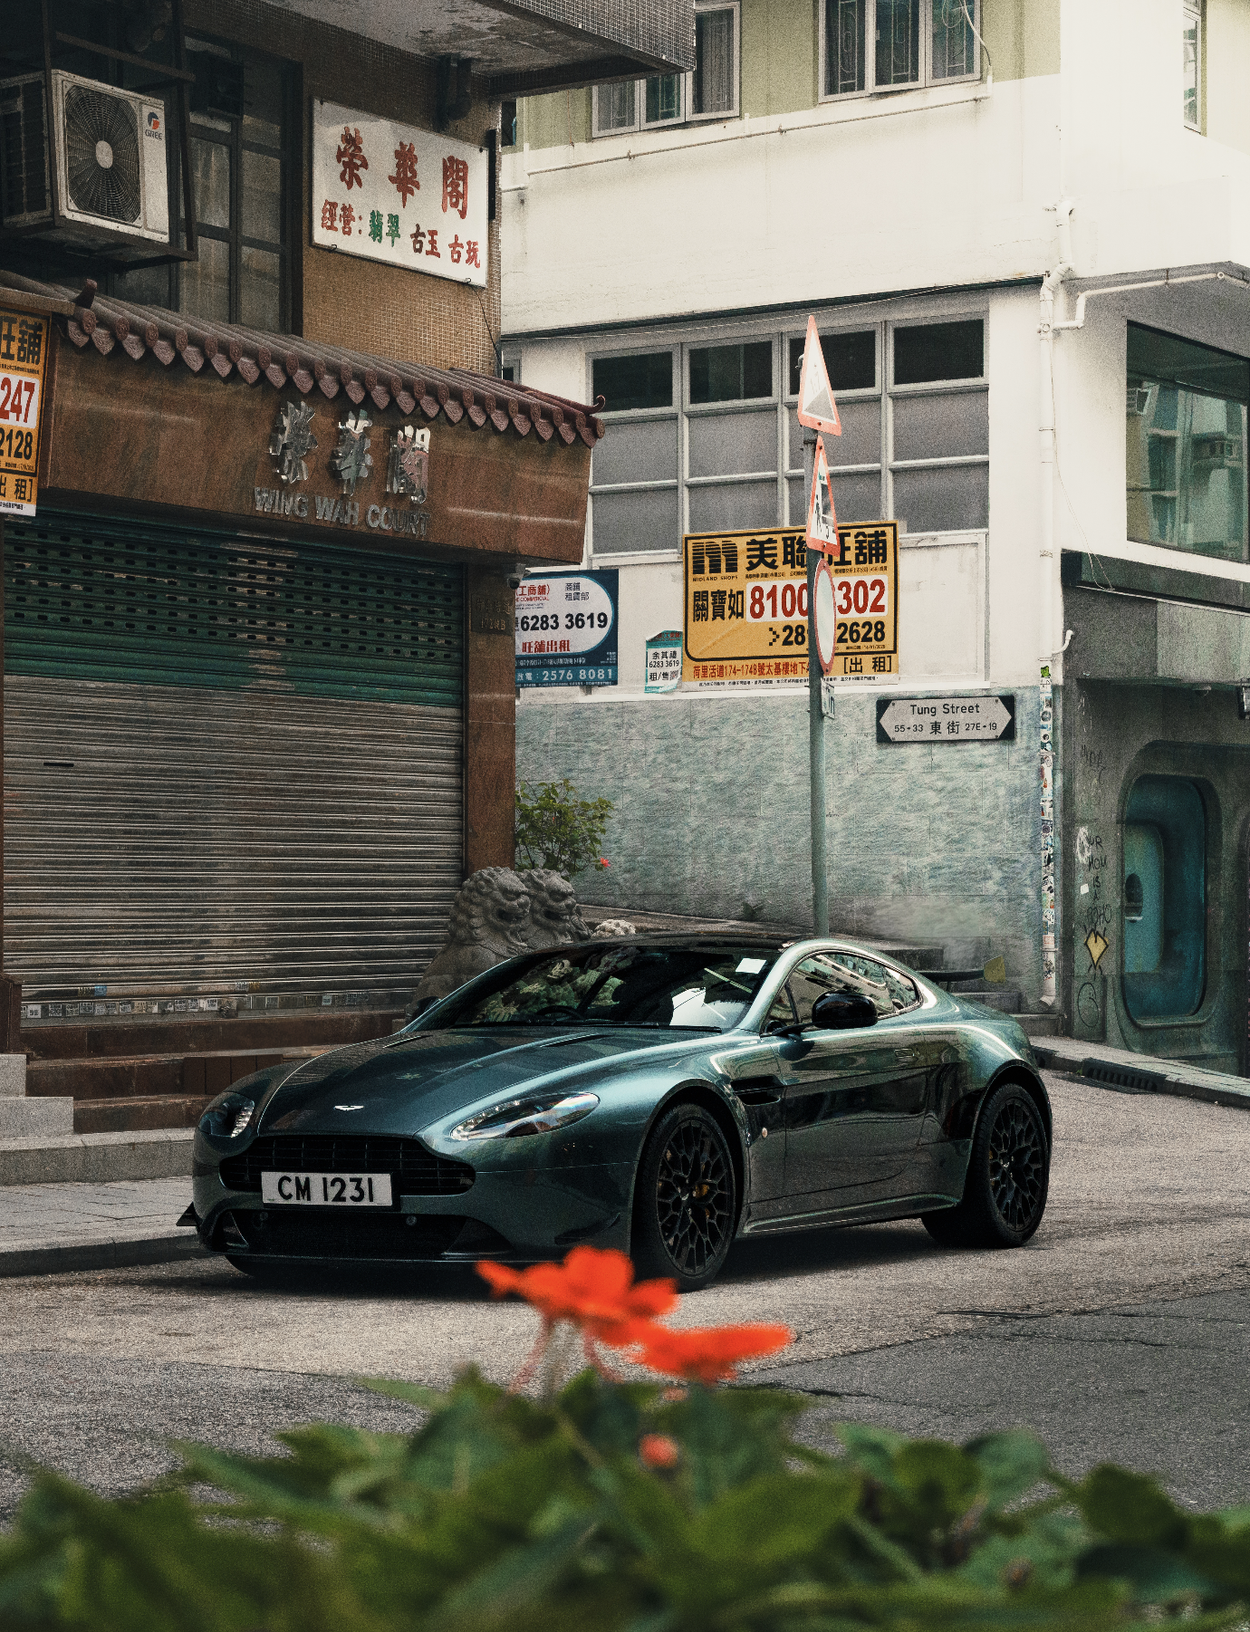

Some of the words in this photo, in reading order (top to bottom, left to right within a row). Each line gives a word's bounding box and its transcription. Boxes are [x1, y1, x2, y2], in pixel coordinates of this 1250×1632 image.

[336, 126, 469, 220] 榮華閣
[368, 210, 400, 248] 翡翠
[254, 486, 309, 518] WING
[315, 496, 360, 525] WAH
[366, 504, 431, 536] COURT
[692, 589, 744, 622] 關寶如
[520, 614, 559, 631] 6283
[564, 612, 608, 629] 3619
[542, 670, 573, 681] 2576
[579, 668, 612, 680] 8081
[649, 661, 664, 669] 6283
[665, 660, 680, 668] 3619
[910, 704, 937, 717] Tung
[943, 703, 980, 715] Street
[929, 721, 960, 735] 東街
[278, 1176, 311, 1201] CM
[322, 1177, 374, 1202] 1231
